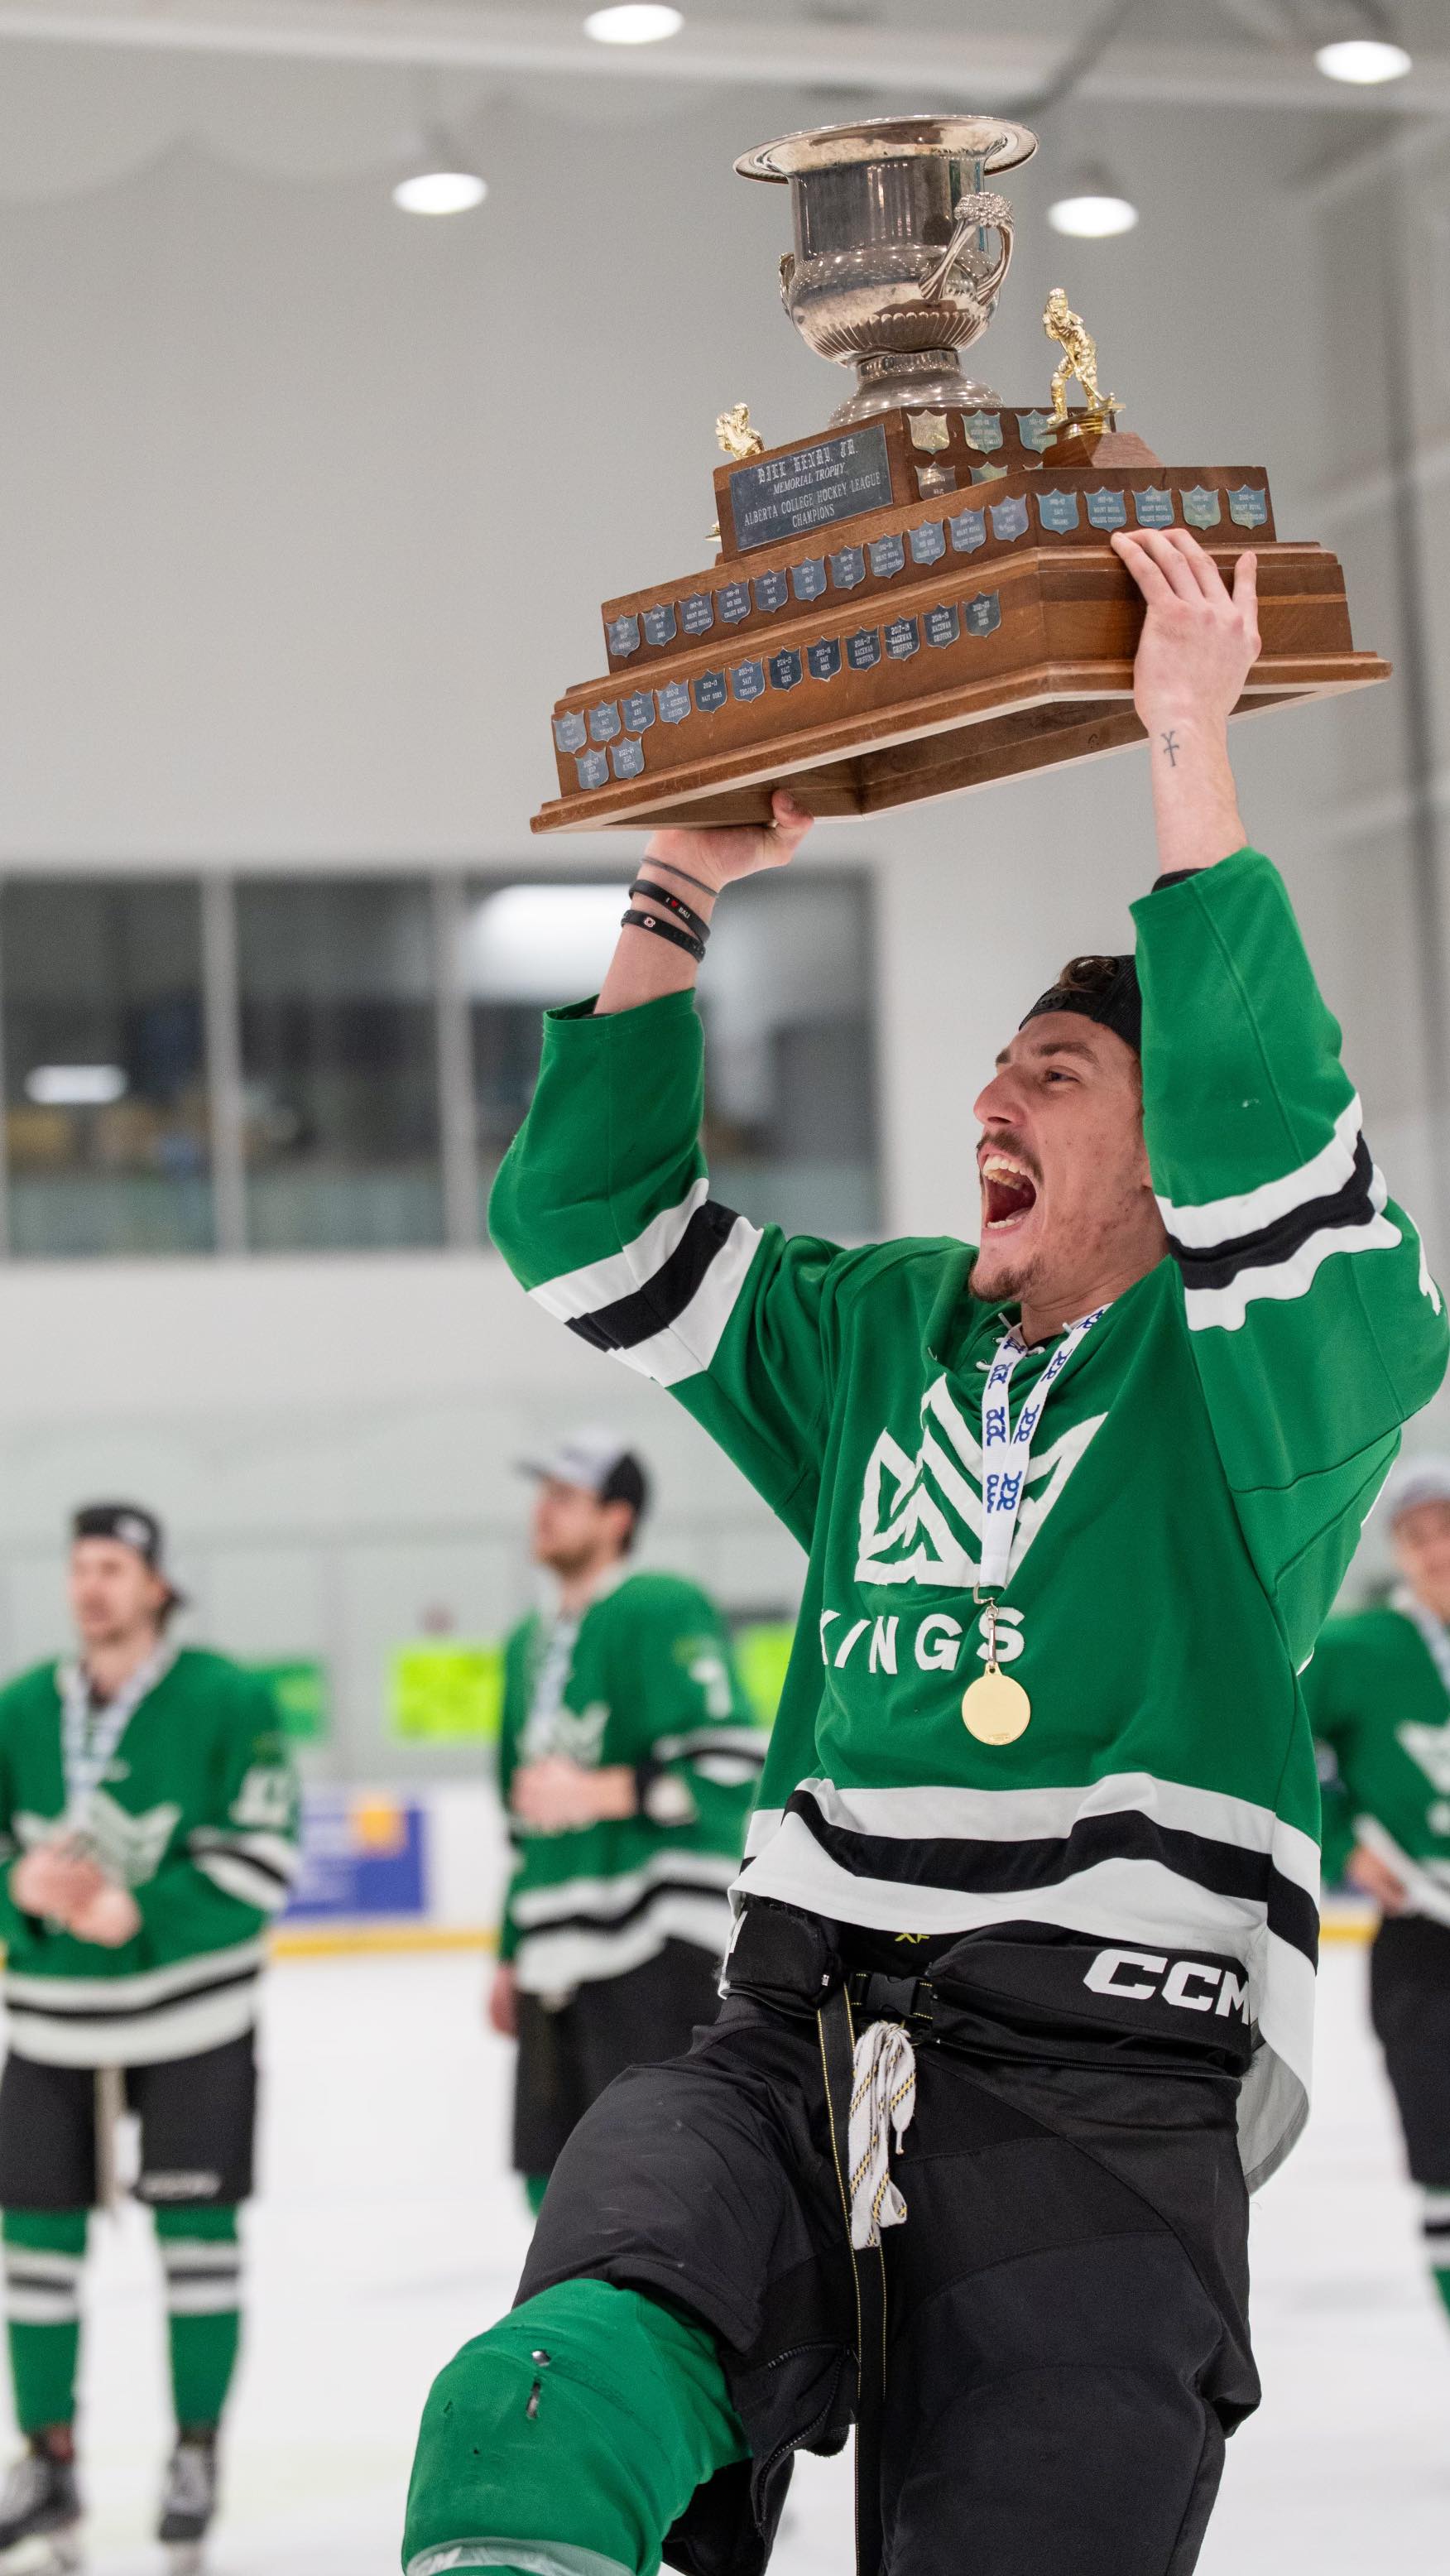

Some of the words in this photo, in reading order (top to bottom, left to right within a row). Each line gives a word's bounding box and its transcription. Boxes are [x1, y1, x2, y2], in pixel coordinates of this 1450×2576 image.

[773, 473, 813, 495] MEMORIAL
[815, 463, 846, 482] TROPHY
[744, 505, 778, 526] ALBERTA
[781, 493, 814, 514] COLLEGE
[818, 483, 847, 503] HOCKEY
[851, 472, 881, 493] LEAGUE
[792, 504, 835, 528] CHAMPIONS
[679, 907, 689, 919] BALI
[1083, 1949, 1250, 2026] CCM
